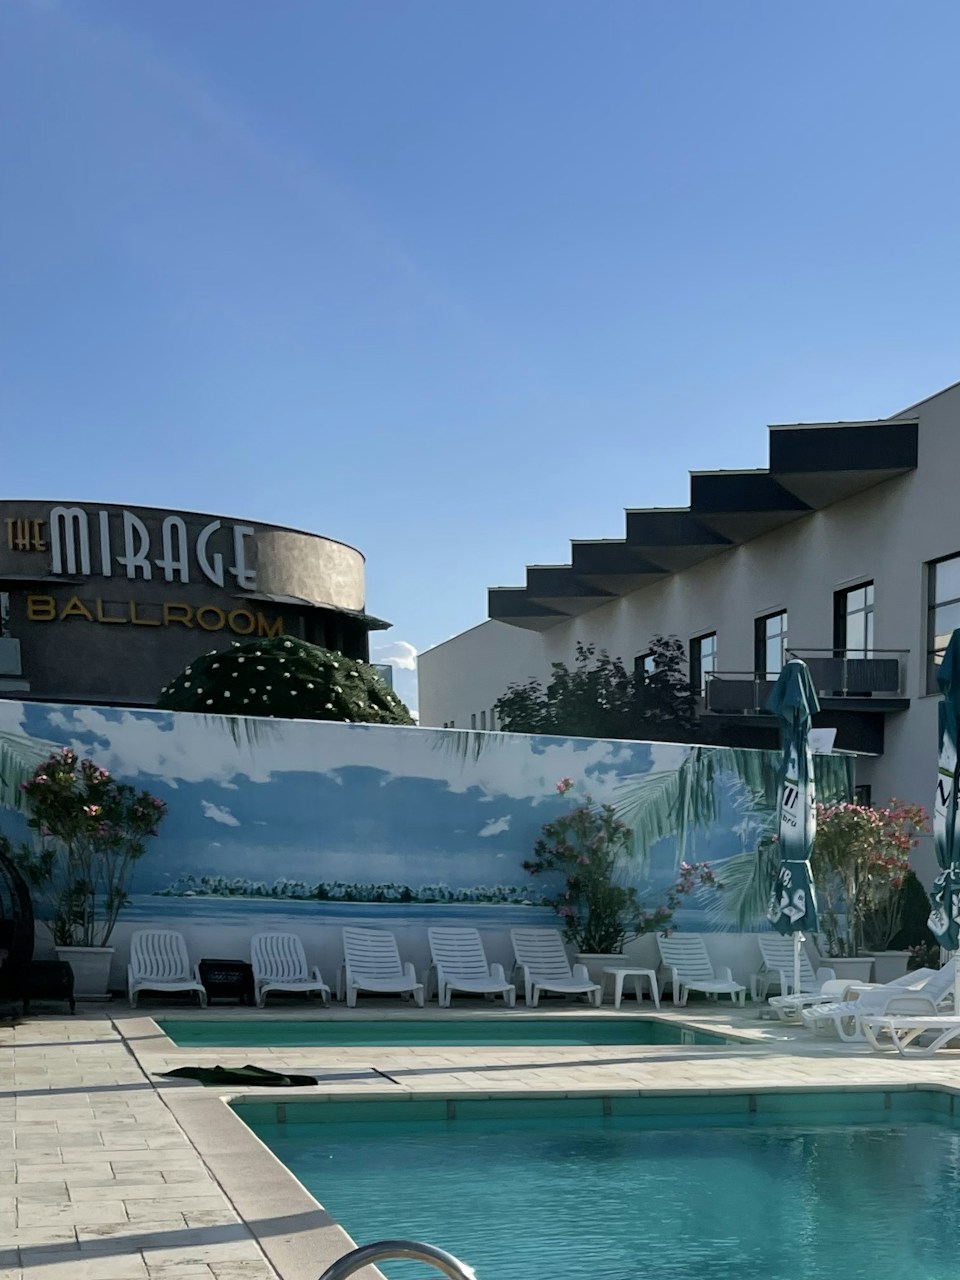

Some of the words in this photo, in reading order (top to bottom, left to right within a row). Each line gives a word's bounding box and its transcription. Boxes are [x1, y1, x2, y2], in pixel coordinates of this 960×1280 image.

[5, 517, 47, 551] THE
[50, 506, 257, 591] MIRAGE
[27, 594, 284, 638] BALLROOM
